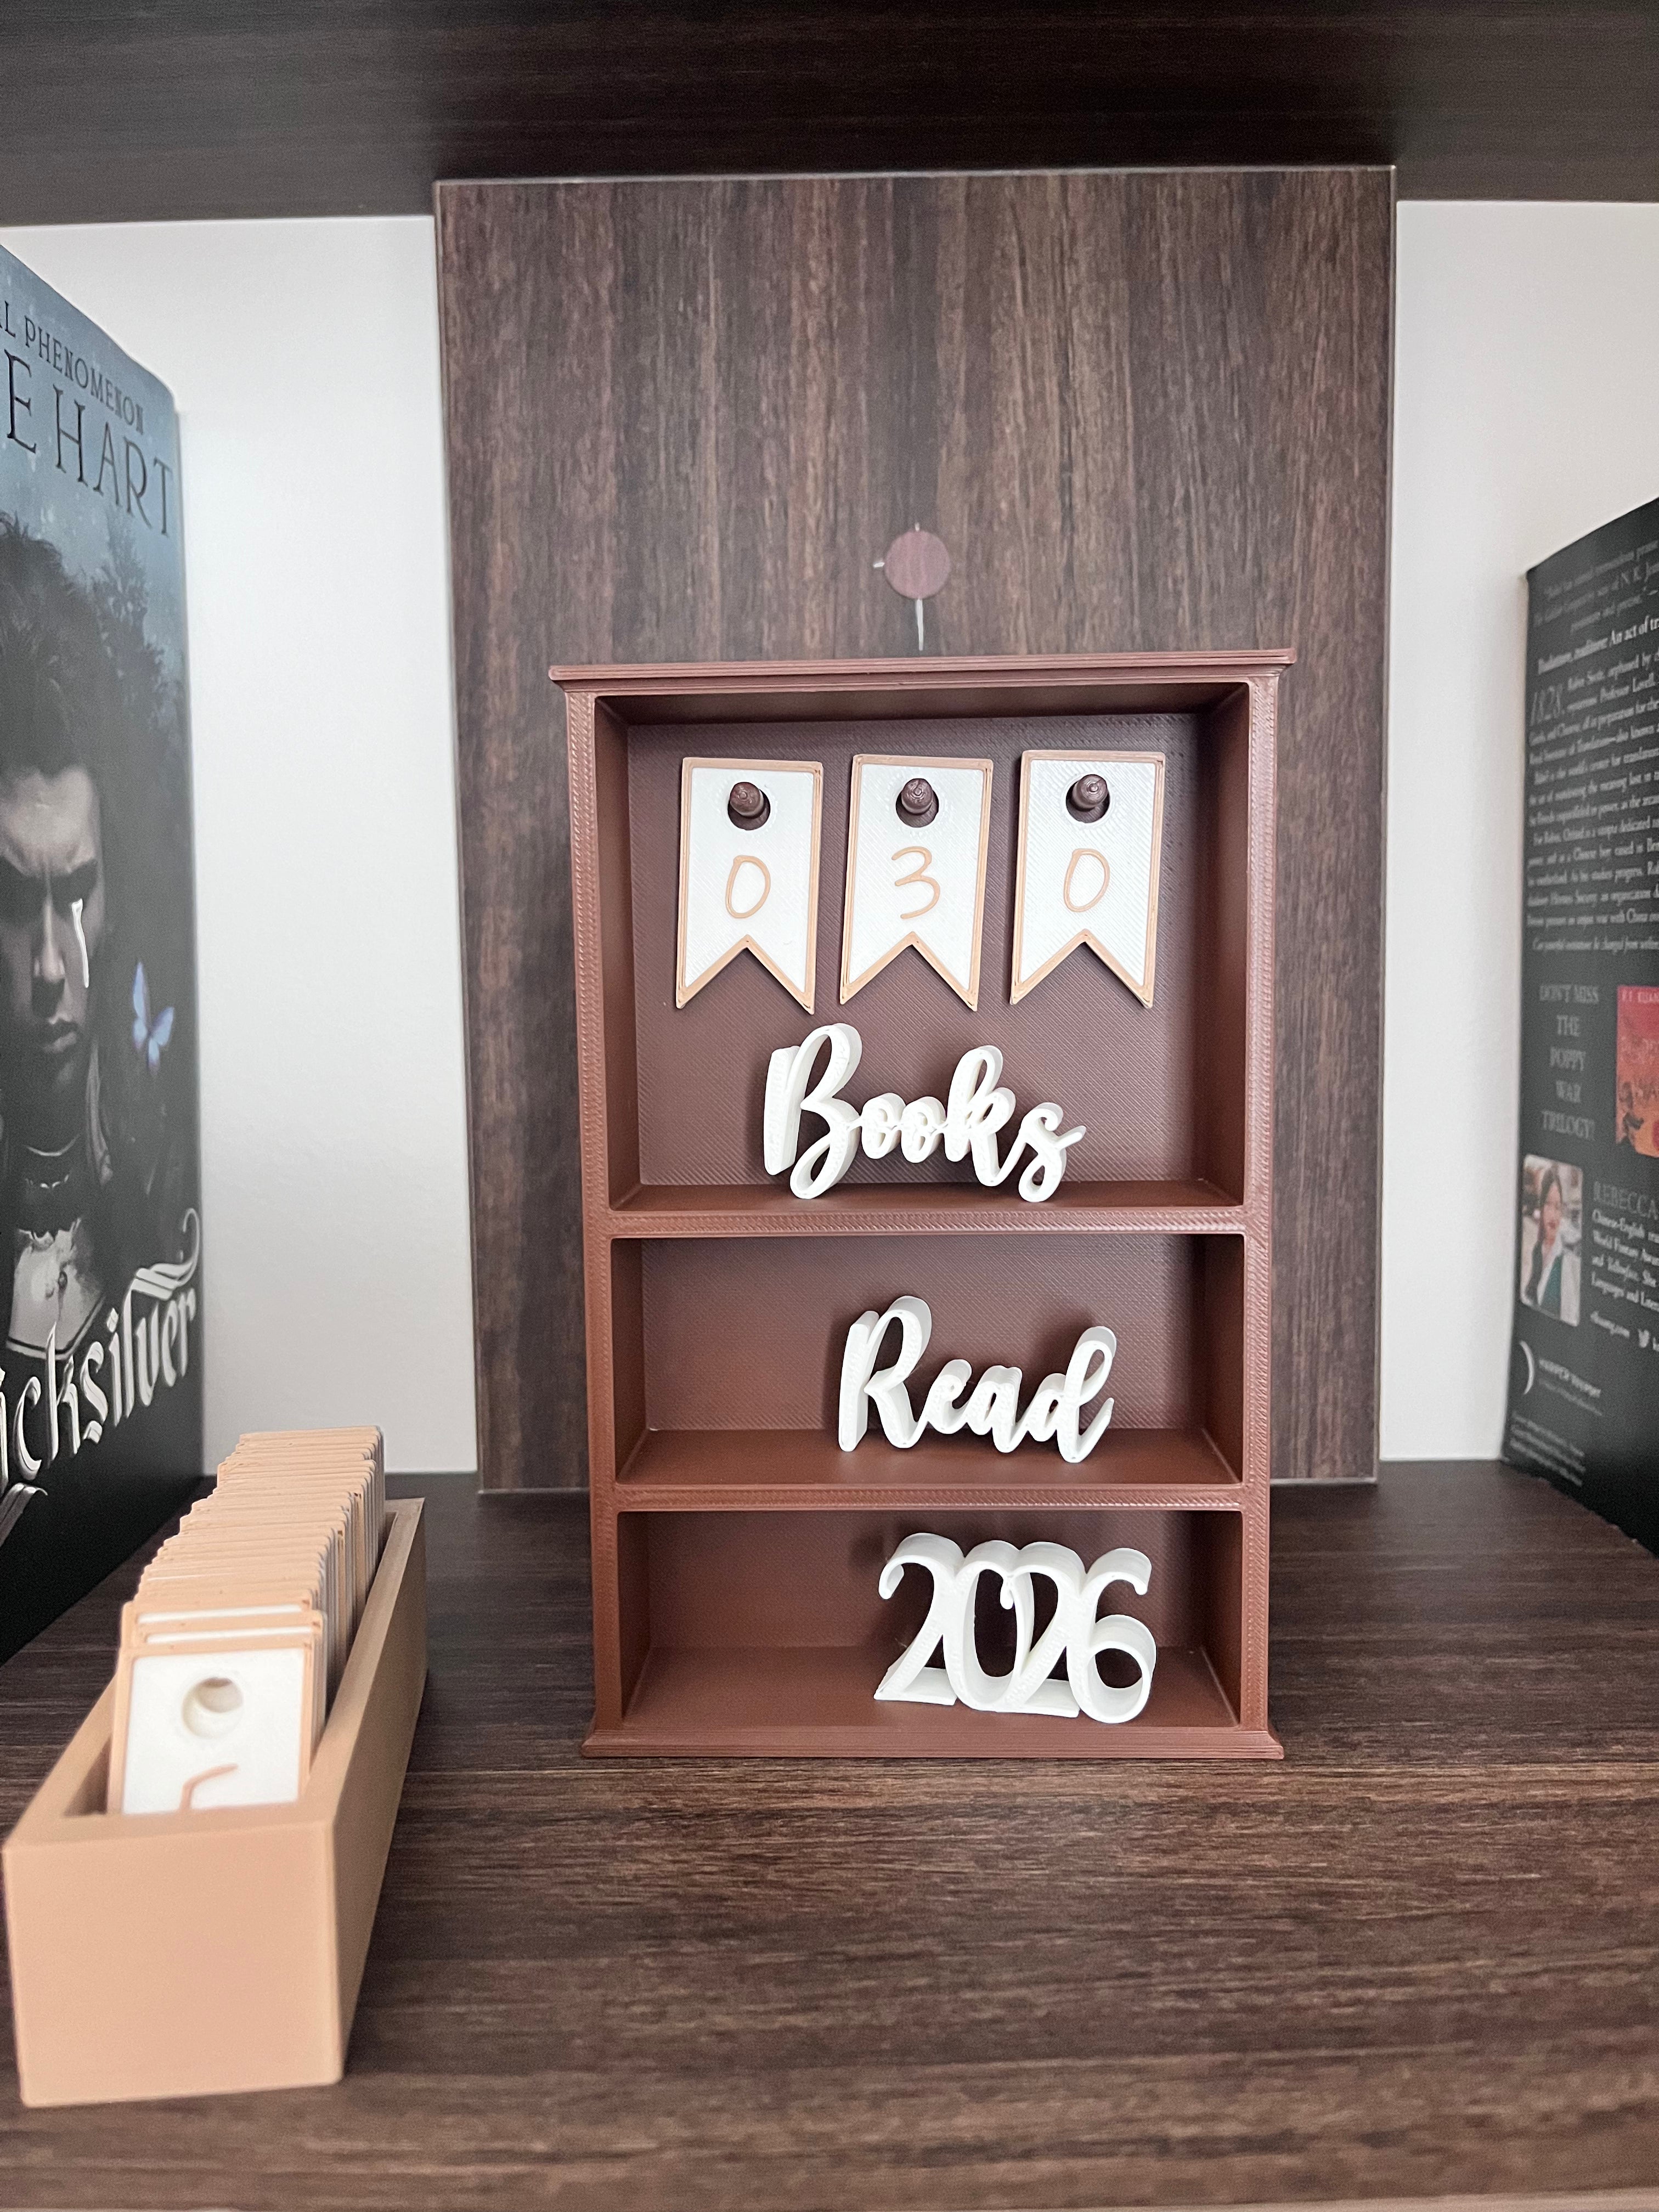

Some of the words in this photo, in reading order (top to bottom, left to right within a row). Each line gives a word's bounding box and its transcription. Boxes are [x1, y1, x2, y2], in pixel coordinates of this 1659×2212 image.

[0, 301, 16, 338] L
[24, 315, 144, 436] PHENOMENON
[4, 349, 37, 454] E
[53, 383, 173, 537] HART
[725, 854, 771, 919] 0
[891, 846, 941, 919] 3
[1063, 848, 1110, 912] 0
[1556, 1015, 1581, 1037] THE
[764, 1022, 1087, 1203] Books
[838, 1295, 1117, 1463] Read
[873, 1533, 1157, 1724] 2026
